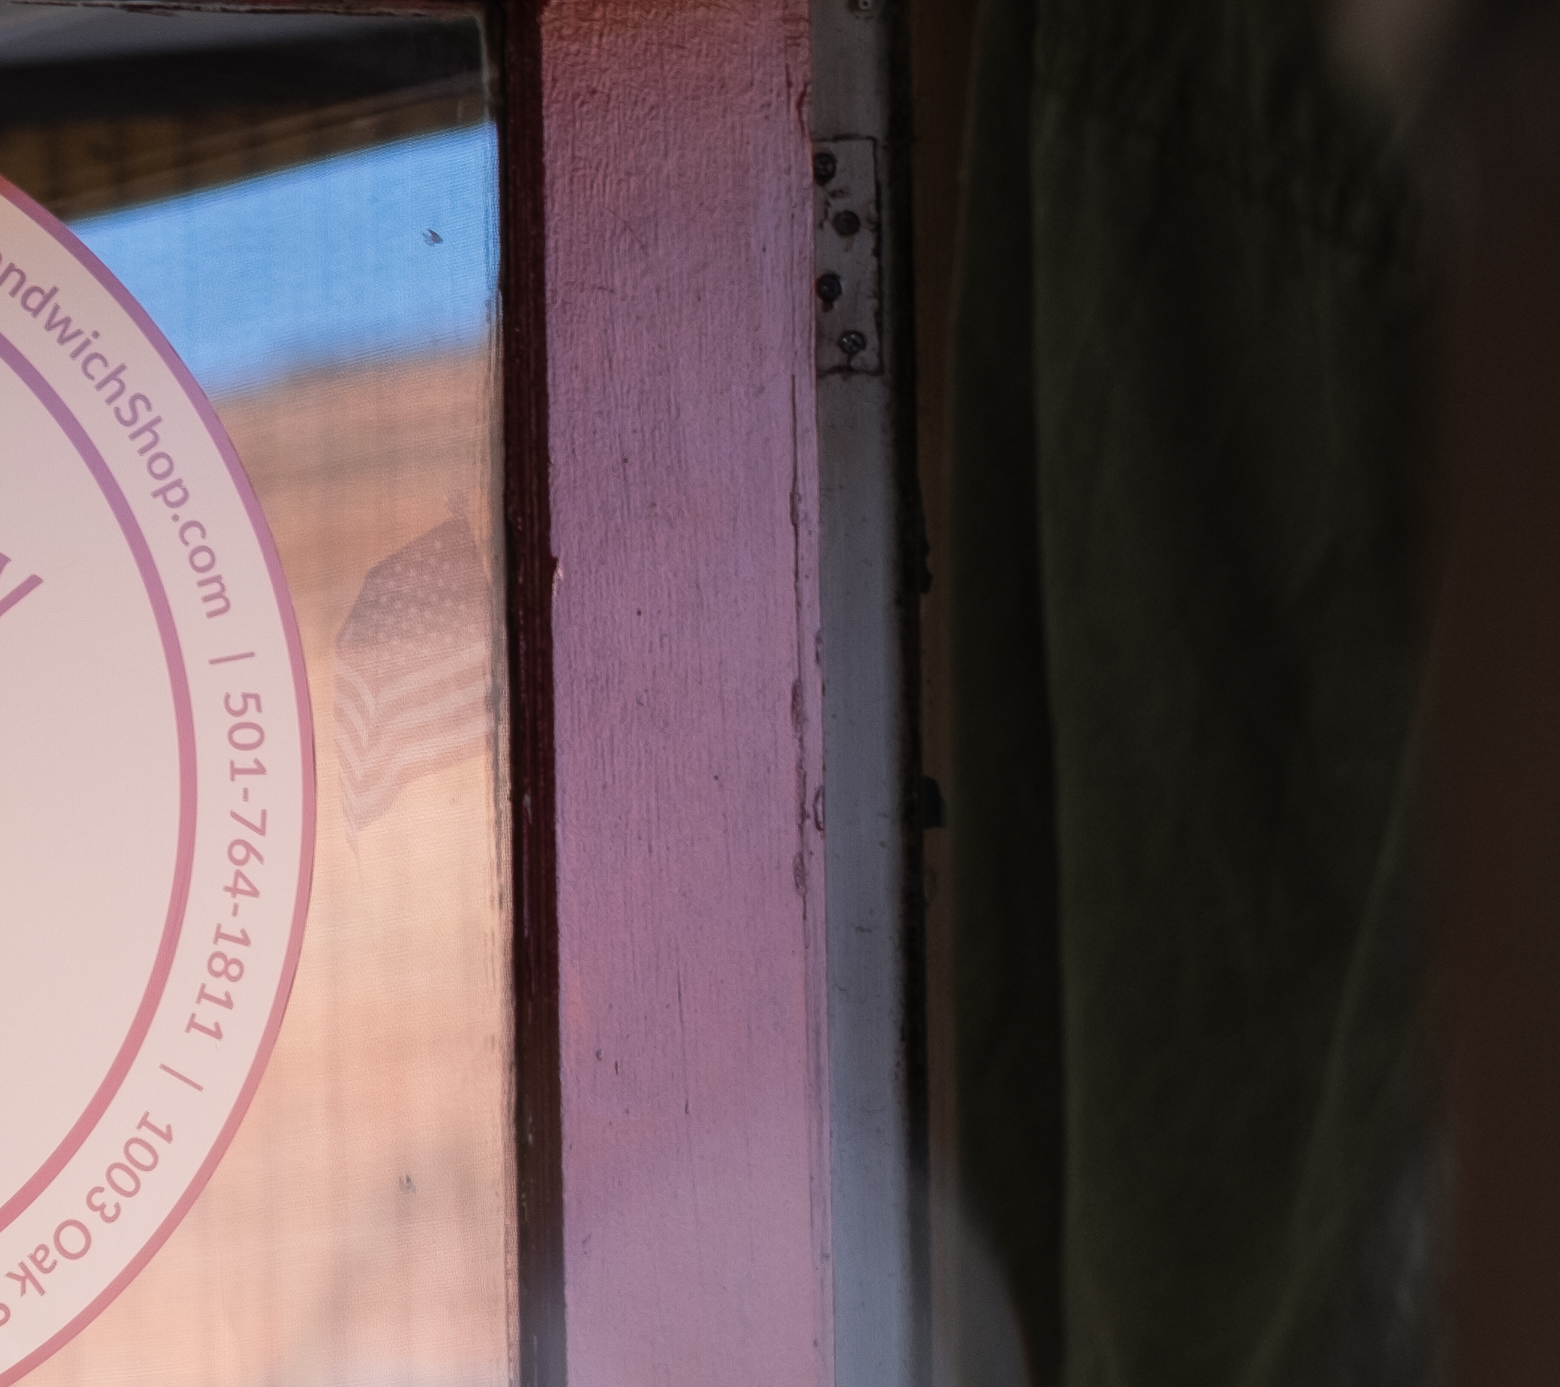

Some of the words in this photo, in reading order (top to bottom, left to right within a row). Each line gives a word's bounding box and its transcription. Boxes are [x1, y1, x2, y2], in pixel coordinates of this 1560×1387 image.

[186, 691, 267, 1042] 501-764-1811
[86, 1110, 175, 1224] 1003
[6, 1217, 92, 1301] Oak
